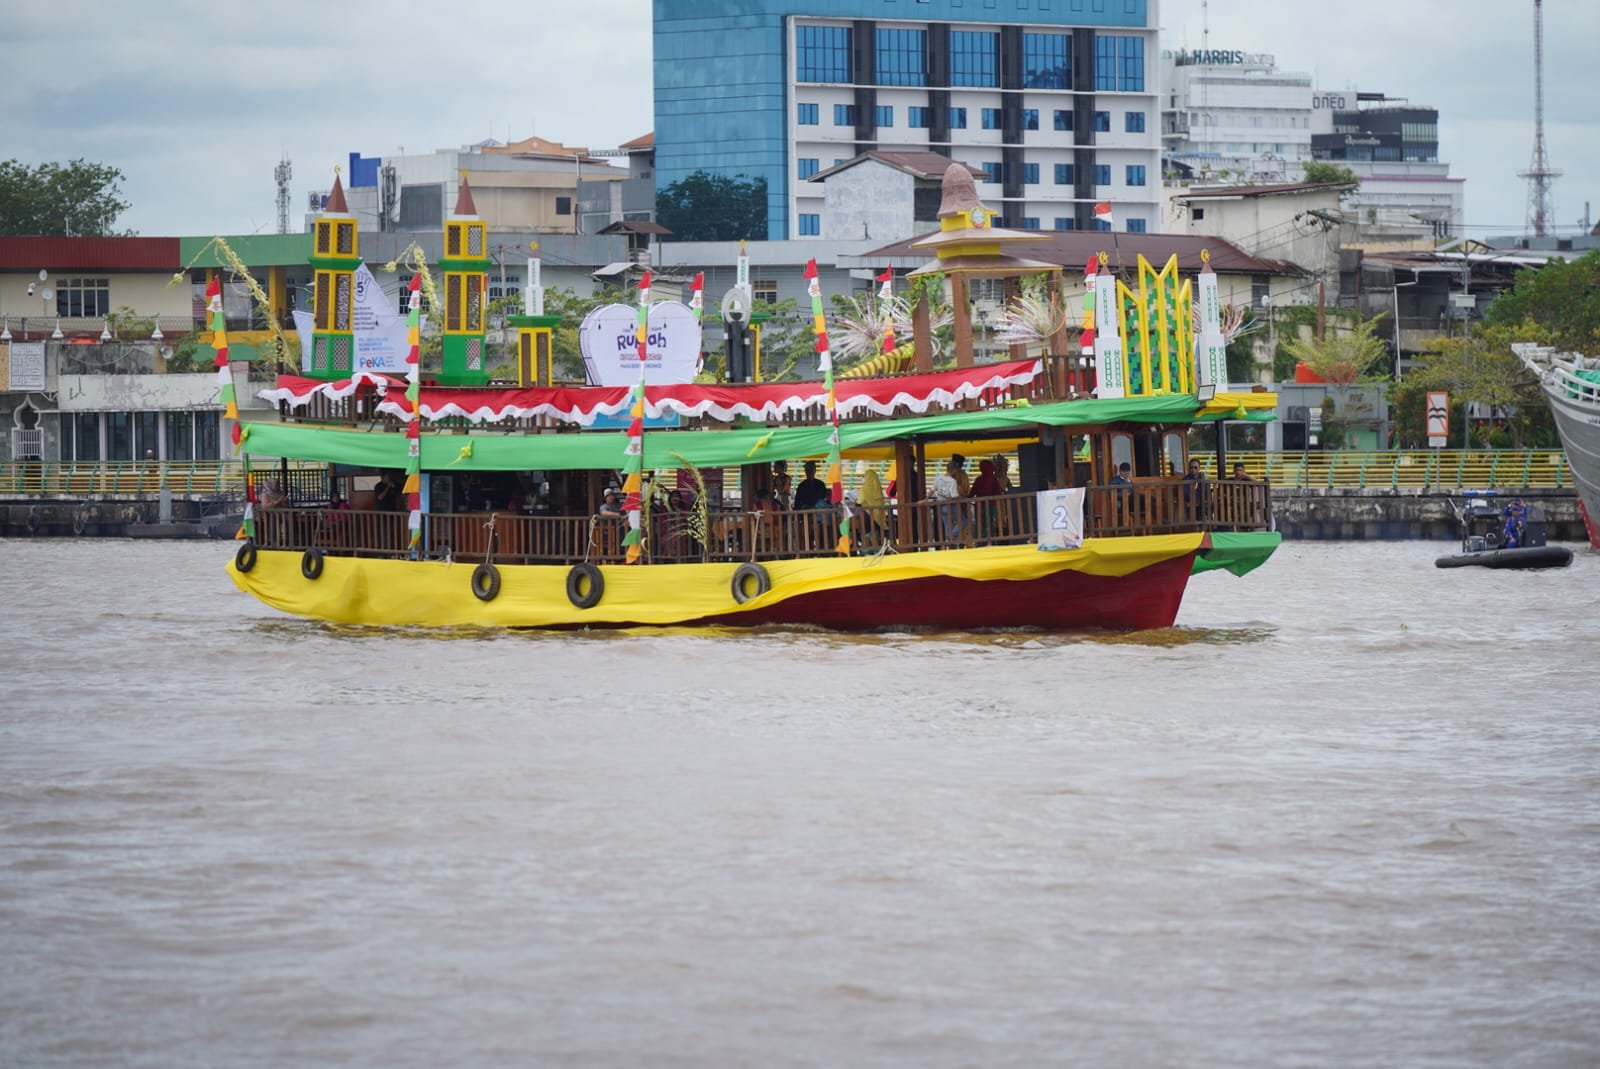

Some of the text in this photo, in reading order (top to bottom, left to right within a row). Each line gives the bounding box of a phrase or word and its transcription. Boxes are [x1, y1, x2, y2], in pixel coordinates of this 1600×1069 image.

[1193, 50, 1243, 64] HARRIS
[357, 281, 364, 294] 5
[1052, 505, 1068, 530] 2
